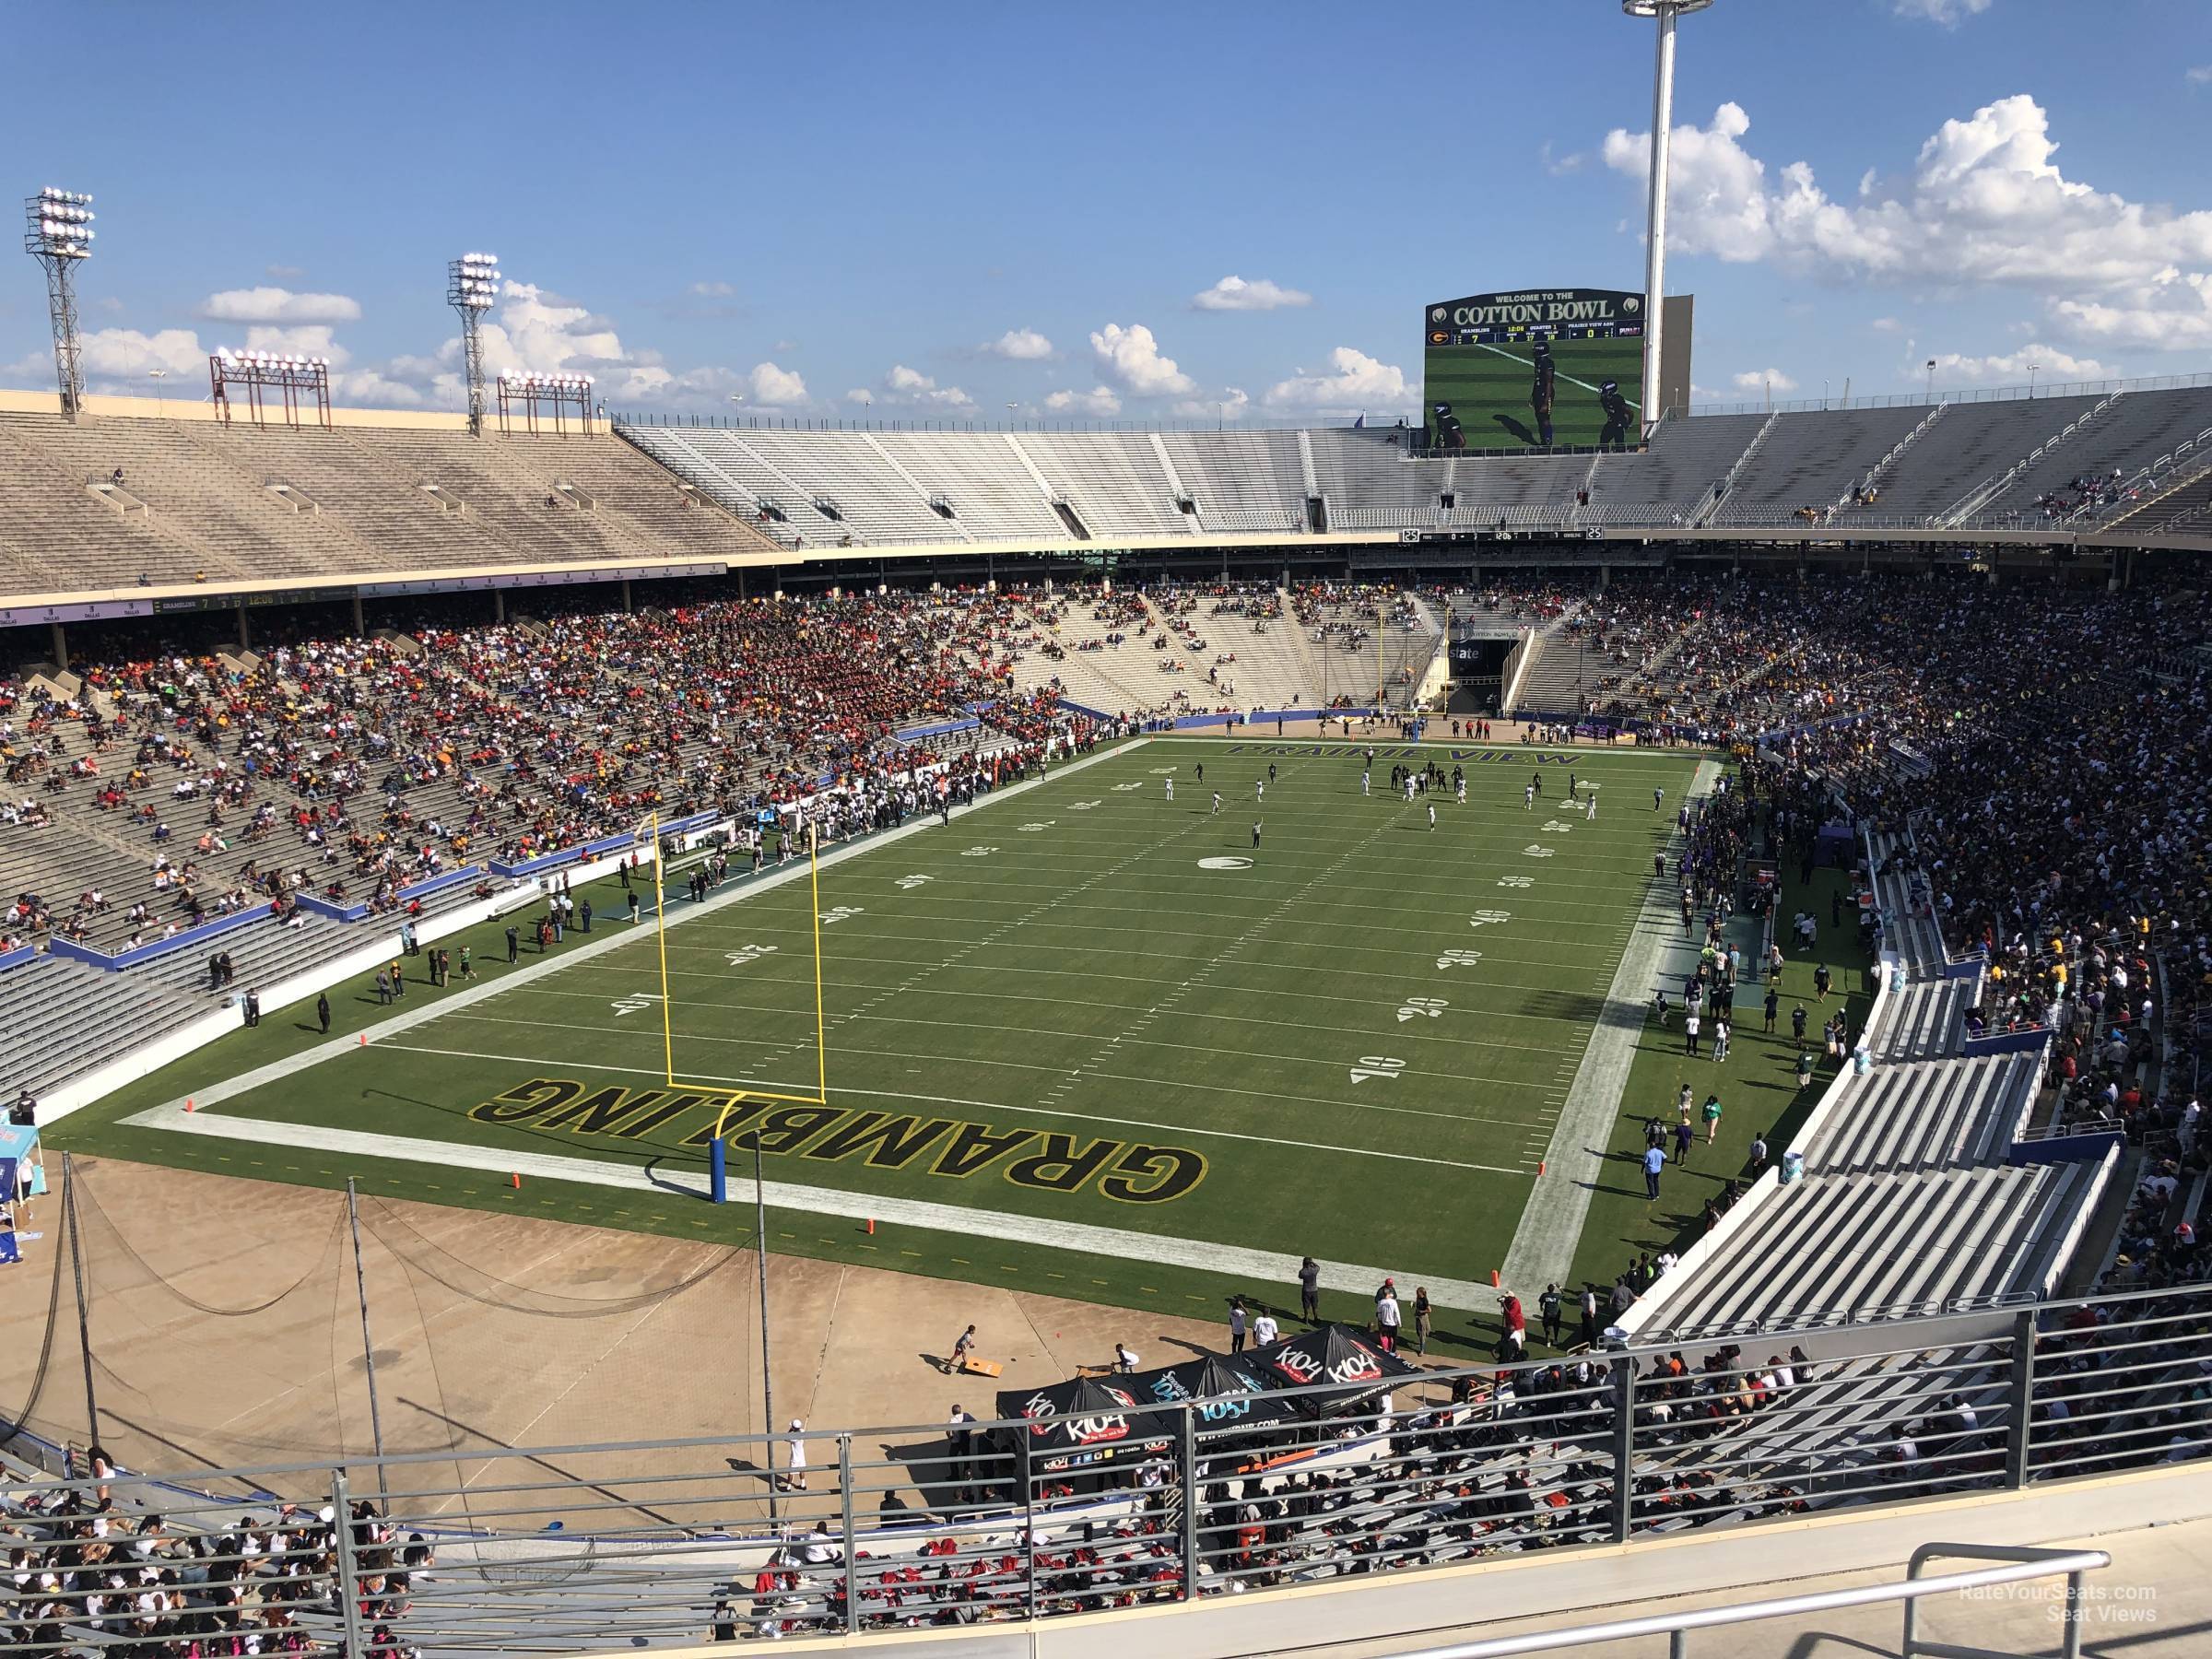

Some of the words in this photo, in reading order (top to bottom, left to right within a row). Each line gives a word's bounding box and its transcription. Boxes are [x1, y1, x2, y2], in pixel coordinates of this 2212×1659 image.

[1495, 294, 1540, 303] WELCOME
[1556, 291, 1574, 300] THE
[1453, 303, 1544, 325] COTTON
[1547, 300, 1615, 321] BOWL
[1472, 335, 1479, 344] 7
[1587, 329, 1594, 338] 0
[1405, 530, 1418, 541] 25
[1588, 527, 1601, 538] 25
[202, 598, 208, 608] 7
[1228, 745, 1434, 759] PRAIRIE
[1449, 749, 1585, 765] VIEW
[960, 846, 1000, 856] 50
[1497, 876, 1535, 888] 50
[818, 906, 865, 920] 30
[1470, 910, 1512, 924] 40
[724, 944, 779, 959] 20
[1437, 949, 1482, 966] 30
[610, 993, 670, 1009] 10
[1397, 997, 1450, 1018] 20
[1349, 1055, 1406, 1078] 10
[465, 1077, 1210, 1205] GRAMBLING
[1276, 1345, 1324, 1380] K104
[1327, 1353, 1378, 1383] K104
[1065, 1414, 1126, 1441] K104
